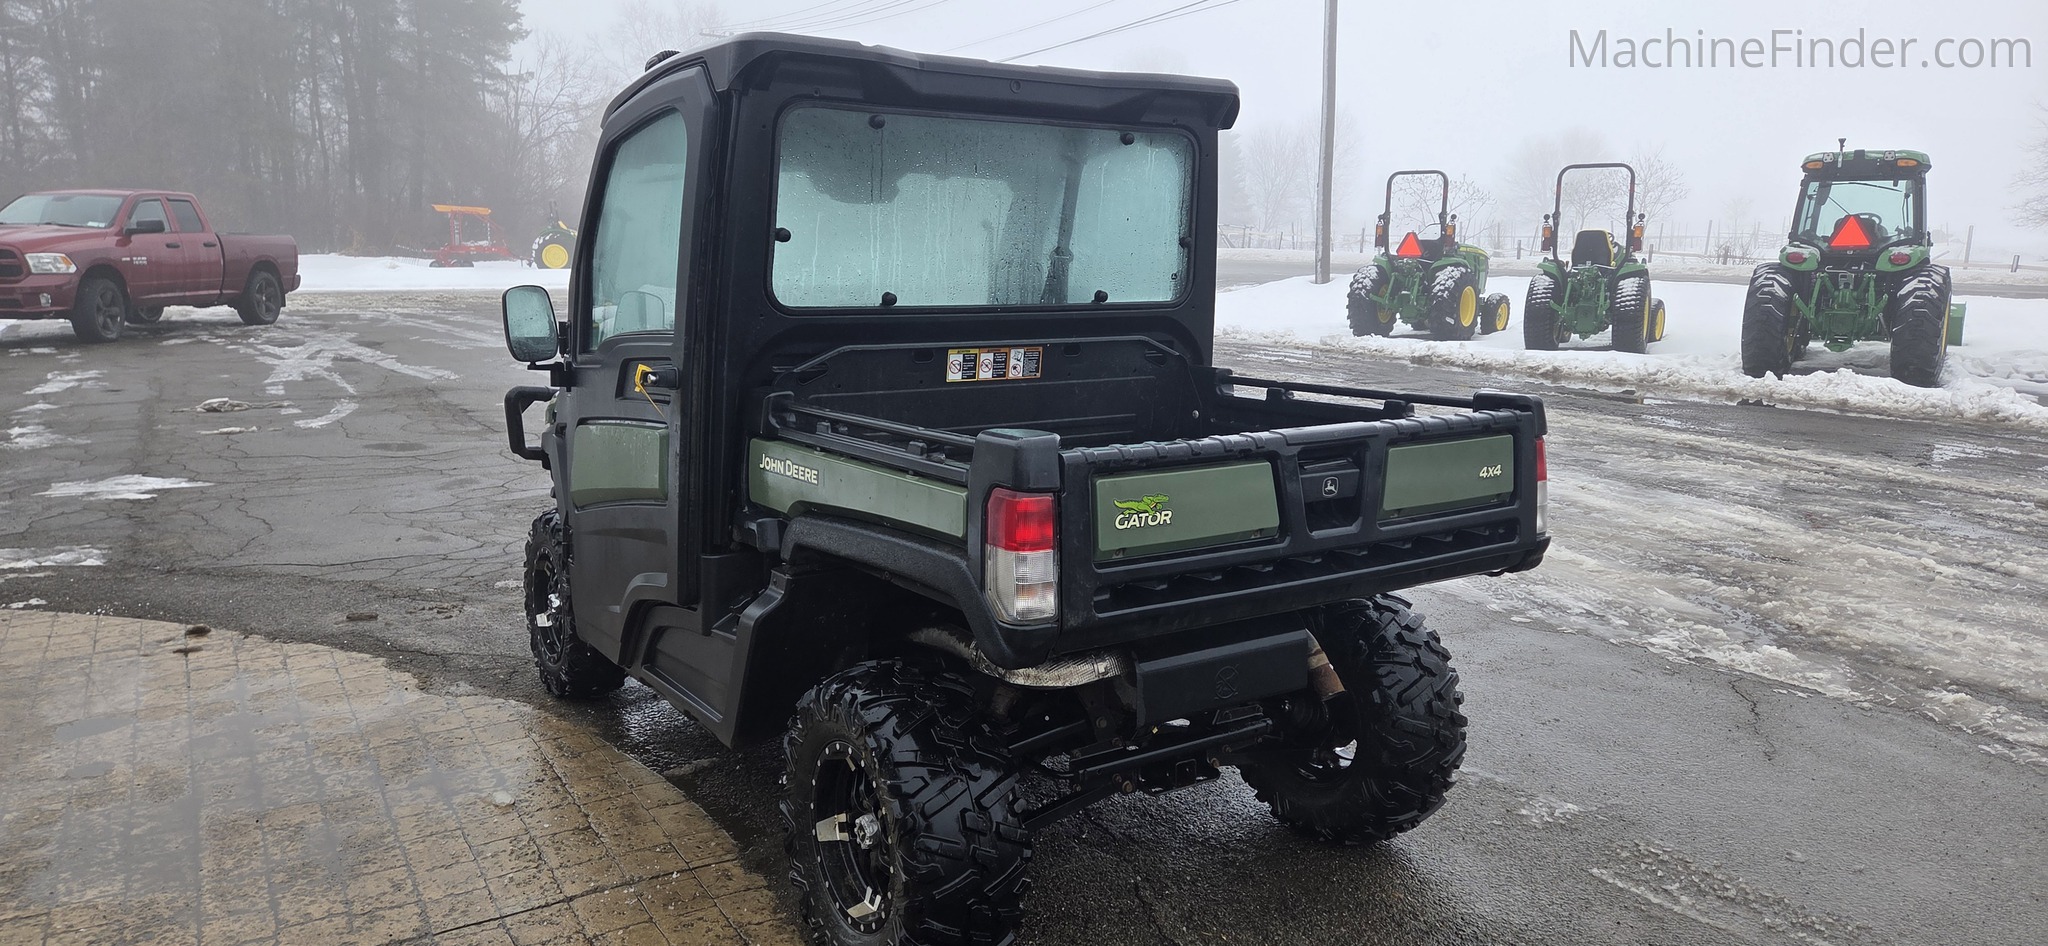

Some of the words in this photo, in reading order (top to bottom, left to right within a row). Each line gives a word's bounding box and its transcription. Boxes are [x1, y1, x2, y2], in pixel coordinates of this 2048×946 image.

[759, 453, 784, 475] JOHN
[785, 459, 818, 485] DEERE
[1115, 510, 1173, 530] GATOR
